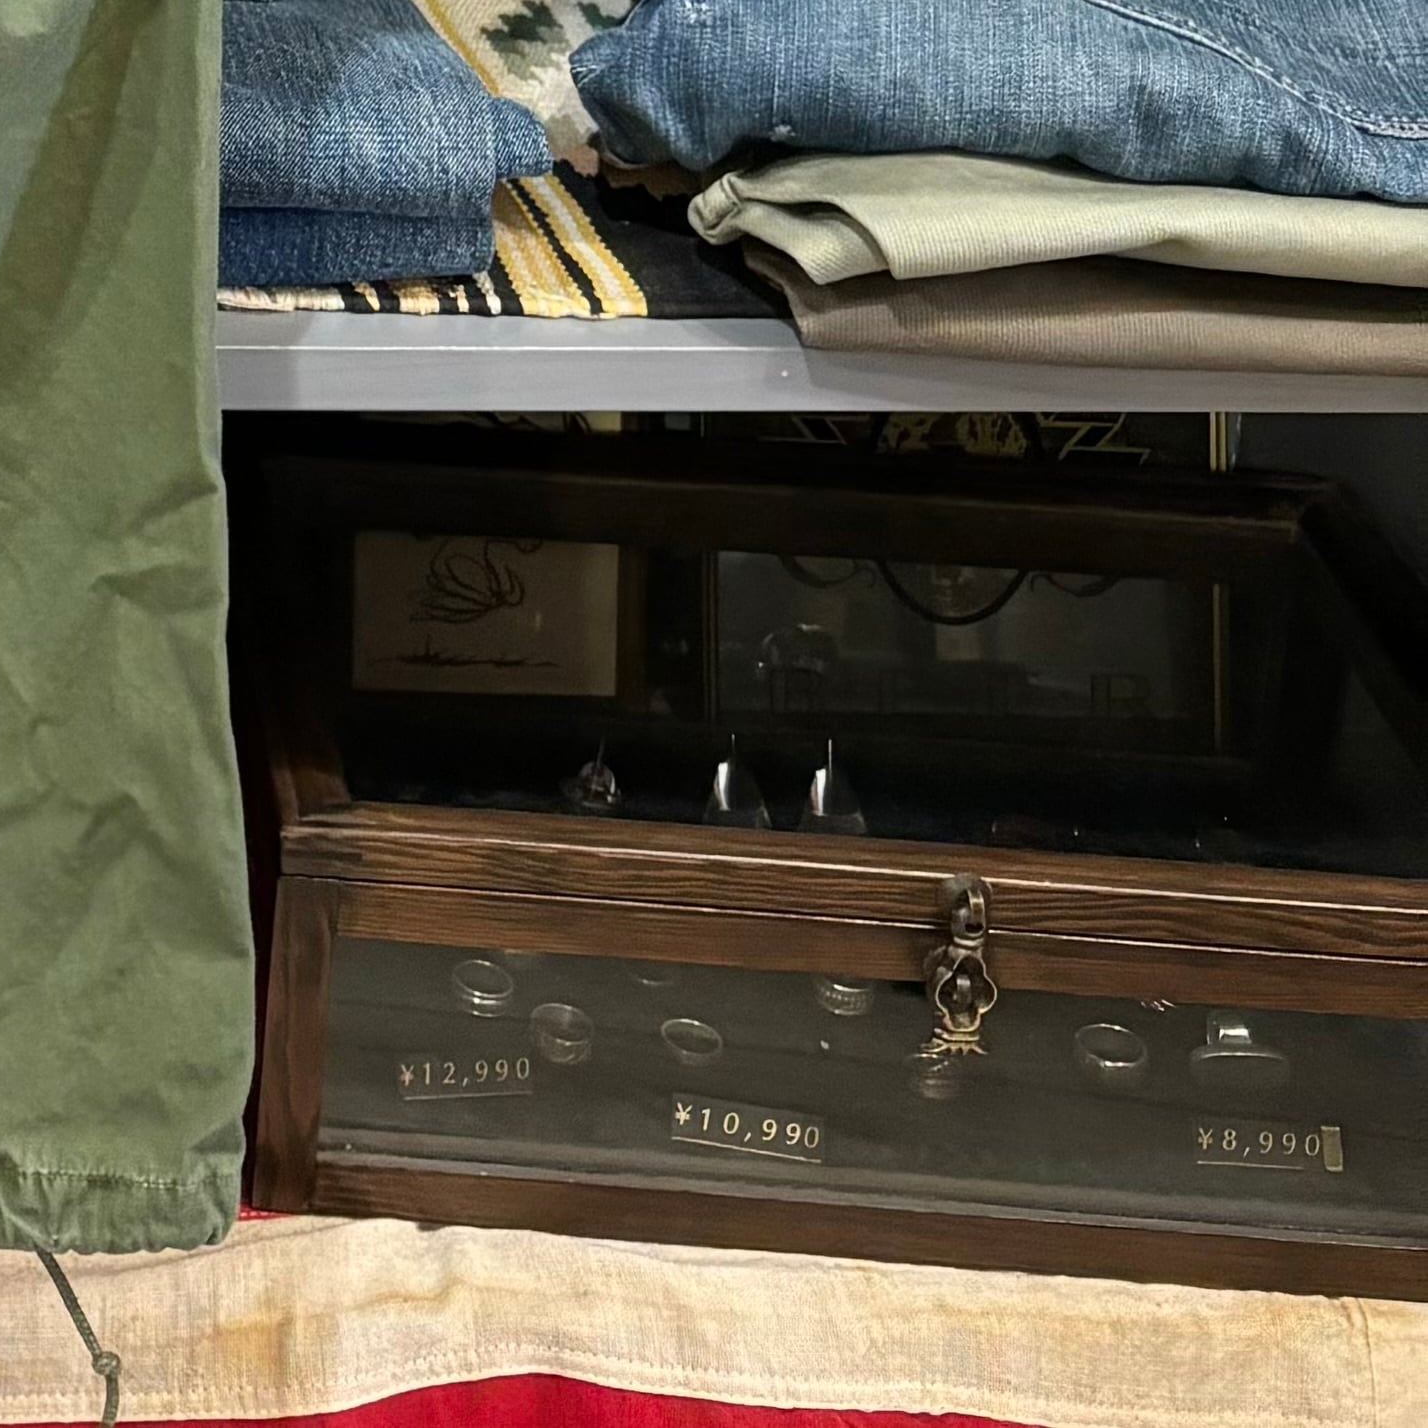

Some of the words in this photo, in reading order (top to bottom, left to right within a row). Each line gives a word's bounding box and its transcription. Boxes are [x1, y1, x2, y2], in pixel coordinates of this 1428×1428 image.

[400, 1056, 531, 1087] ¥12,990
[675, 1102, 821, 1148] ¥10,990
[1198, 1128, 1321, 1157] ¥8,990
